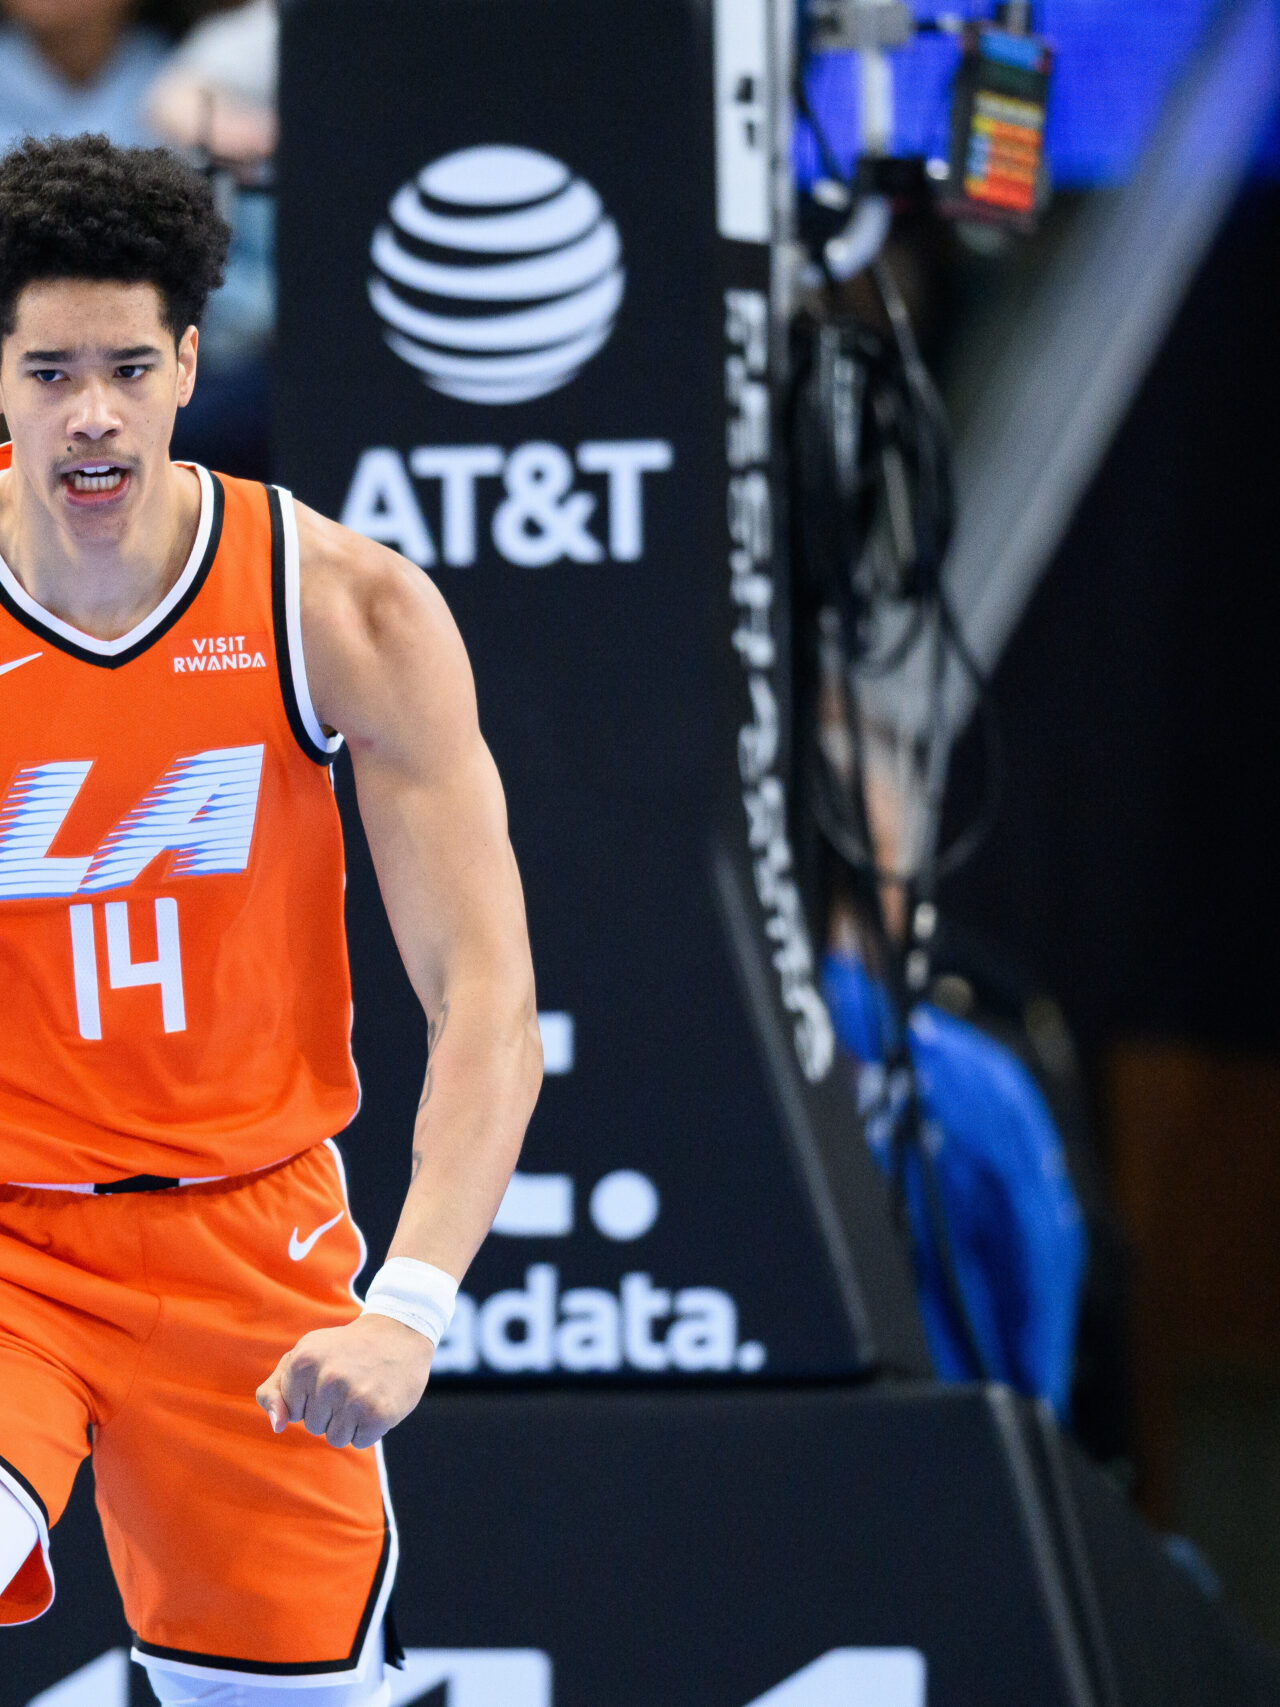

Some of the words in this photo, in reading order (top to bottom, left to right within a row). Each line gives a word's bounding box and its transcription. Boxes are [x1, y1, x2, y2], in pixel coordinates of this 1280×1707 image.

[341, 441, 673, 567] AT&T
[173, 652, 266, 672] RWANDA
[192, 636, 245, 654] VISIT
[69, 897, 187, 1040] 14
[432, 1263, 766, 1373] adata.
